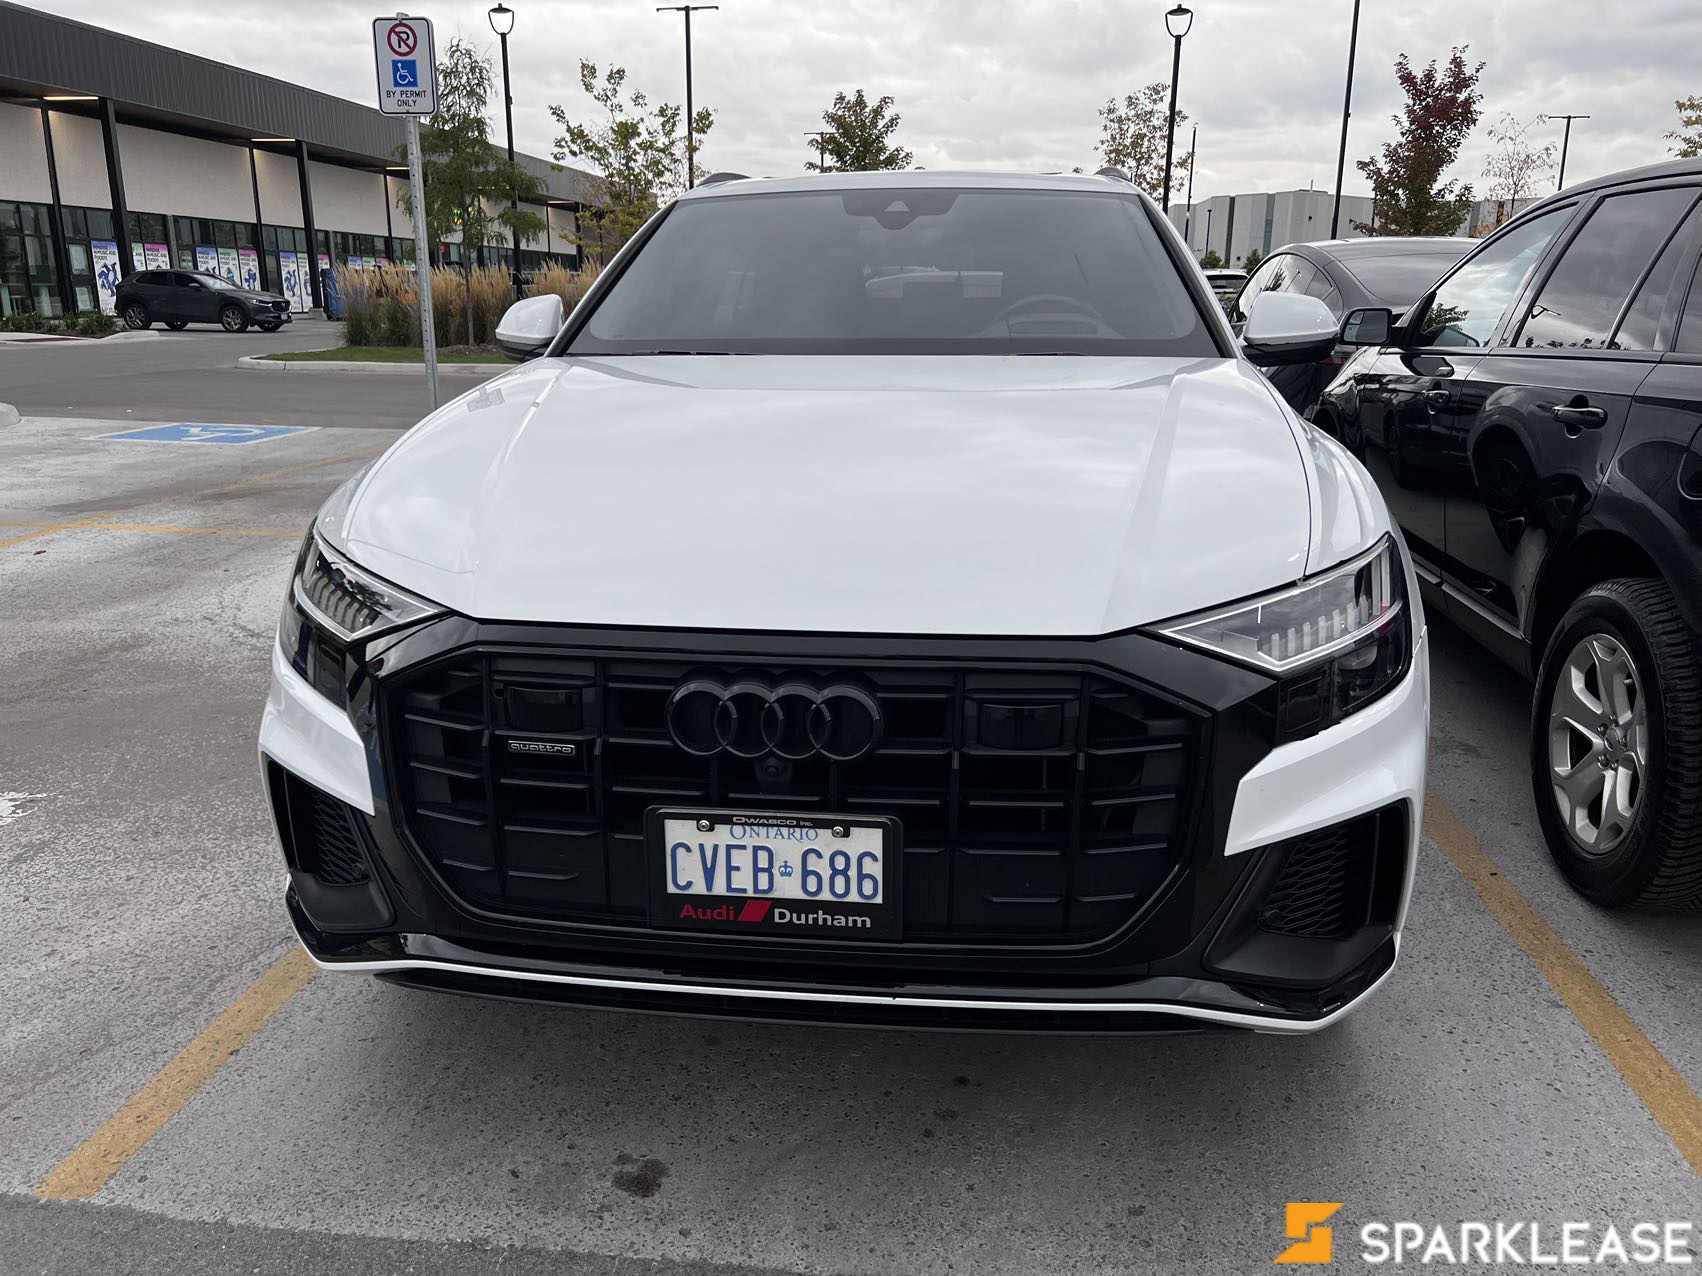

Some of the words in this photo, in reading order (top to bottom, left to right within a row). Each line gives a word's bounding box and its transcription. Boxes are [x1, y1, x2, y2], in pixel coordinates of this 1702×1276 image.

[386, 90, 396, 98] BY
[400, 90, 427, 98] PERMIT
[397, 99, 417, 107] ONLY
[510, 743, 572, 753] quattro
[670, 841, 775, 895] CVEB
[800, 847, 879, 900] 686
[679, 903, 735, 921] Audi
[774, 907, 871, 928] Durham
